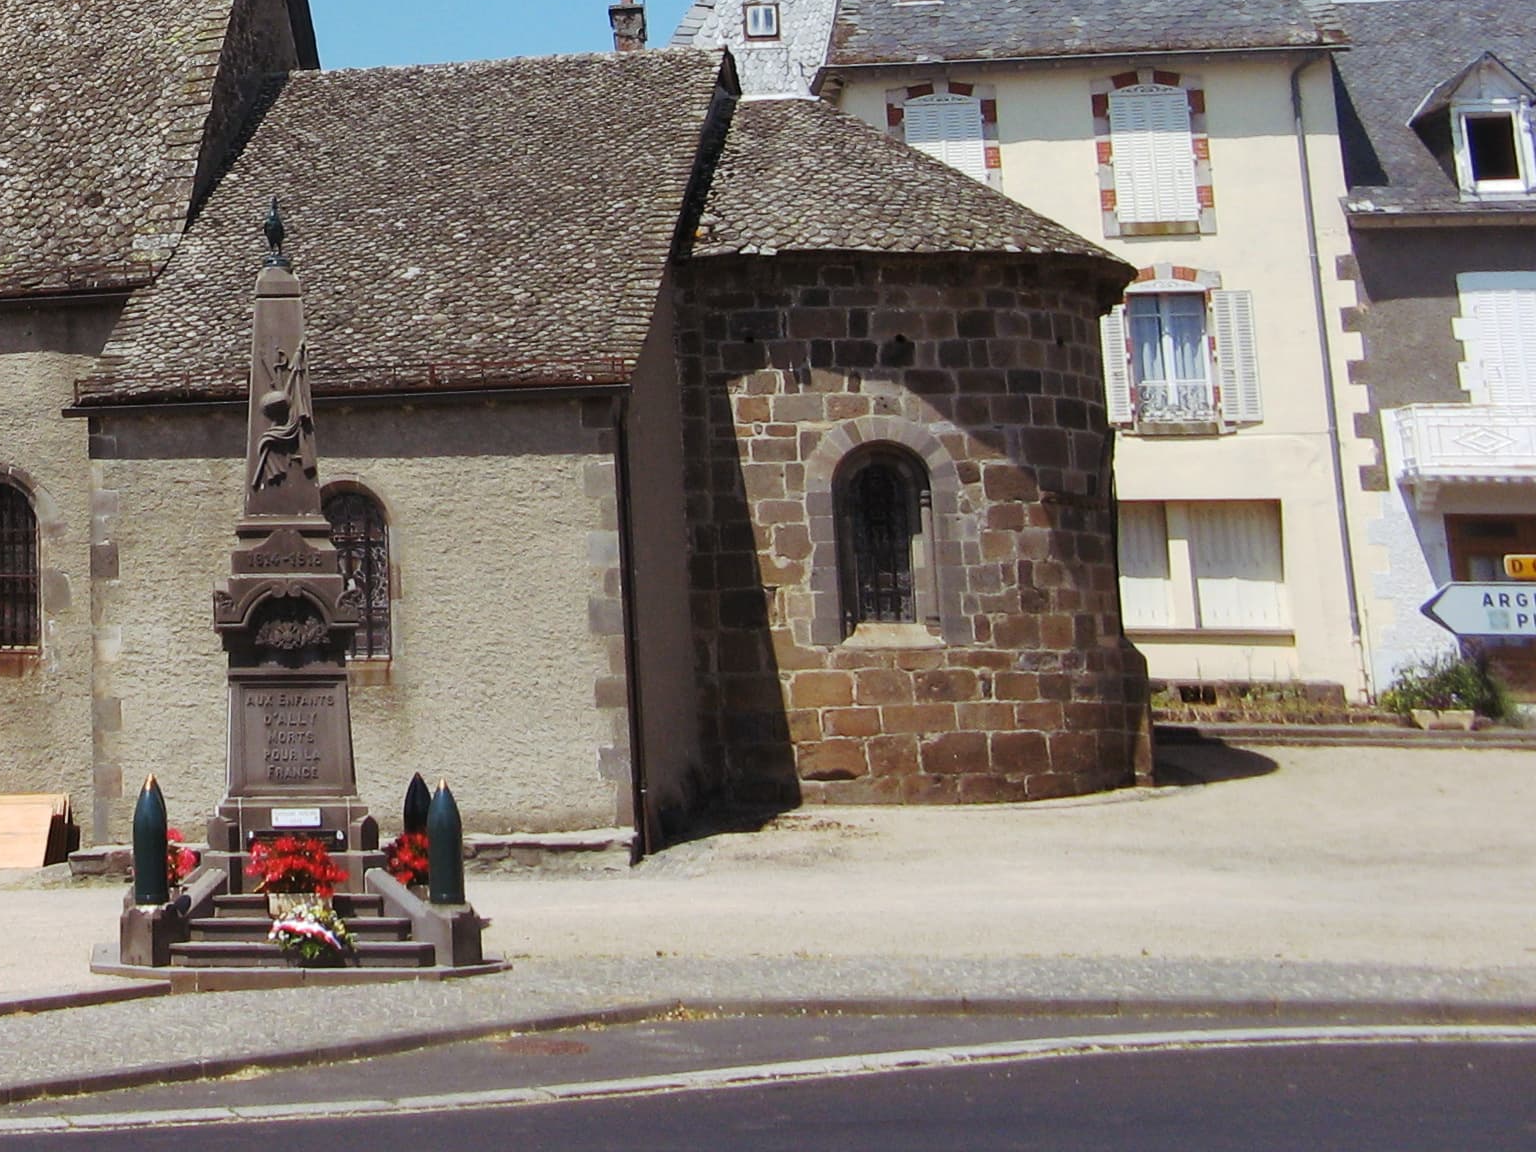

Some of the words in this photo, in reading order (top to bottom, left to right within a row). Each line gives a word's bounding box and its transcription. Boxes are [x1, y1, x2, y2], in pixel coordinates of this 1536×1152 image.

[248, 552, 322, 567] 1914-1918
[1511, 559, 1523, 573] D
[246, 695, 273, 707] AUX
[279, 694, 335, 707] ENFANTS
[263, 712, 318, 727] D'ALLY
[268, 730, 315, 744] MORTS
[264, 748, 298, 762] POUR
[304, 748, 321, 762] LA
[267, 764, 320, 780] FRANCE
